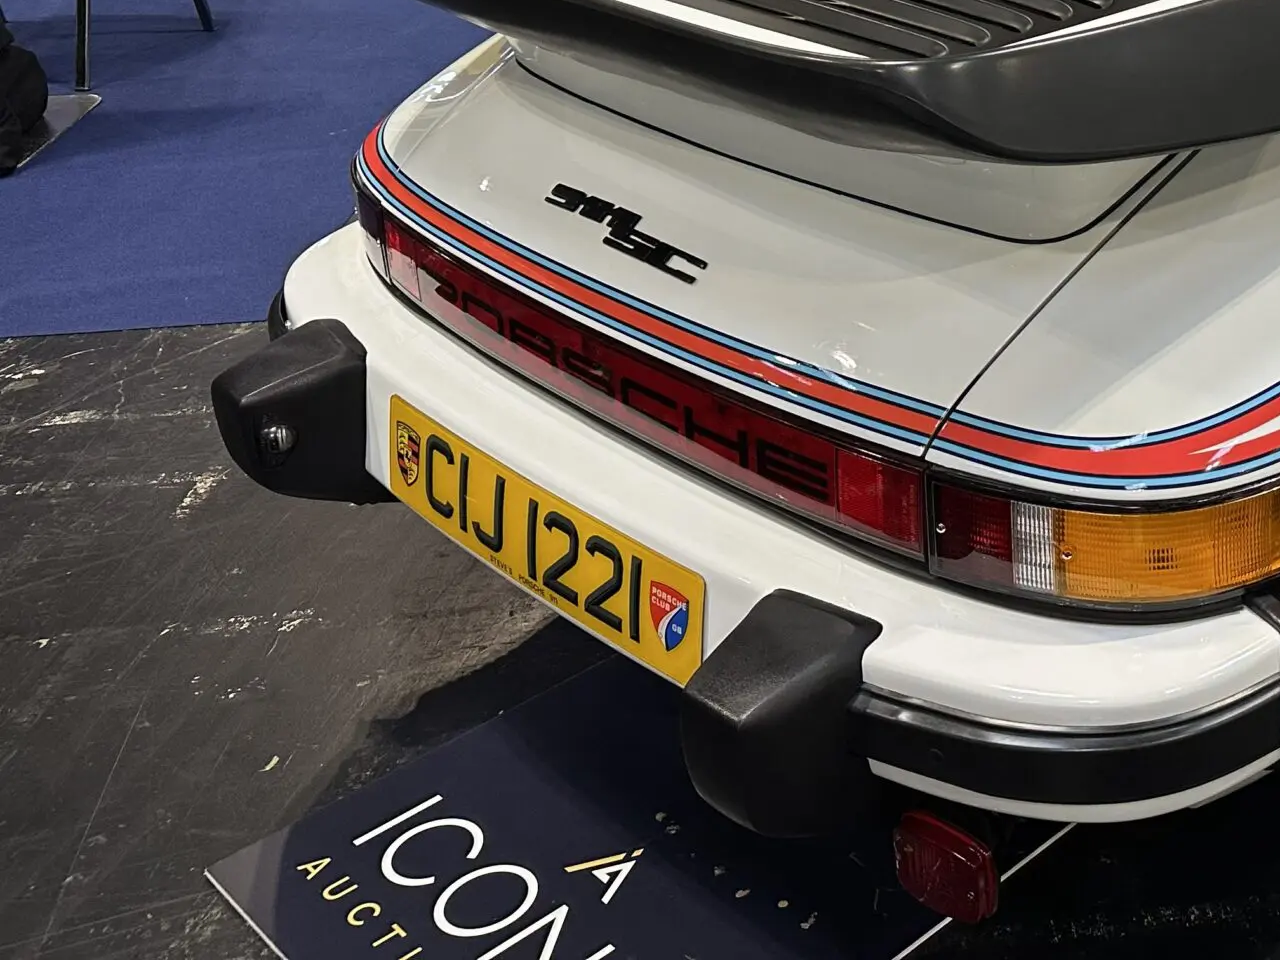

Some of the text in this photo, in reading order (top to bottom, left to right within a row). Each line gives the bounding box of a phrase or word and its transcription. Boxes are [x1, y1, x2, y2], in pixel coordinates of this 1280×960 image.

[418, 262, 830, 503] PORSCHE
[526, 497, 643, 644] 1221
[651, 586, 687, 612] PORSCHE
[651, 595, 671, 612] CLUB
